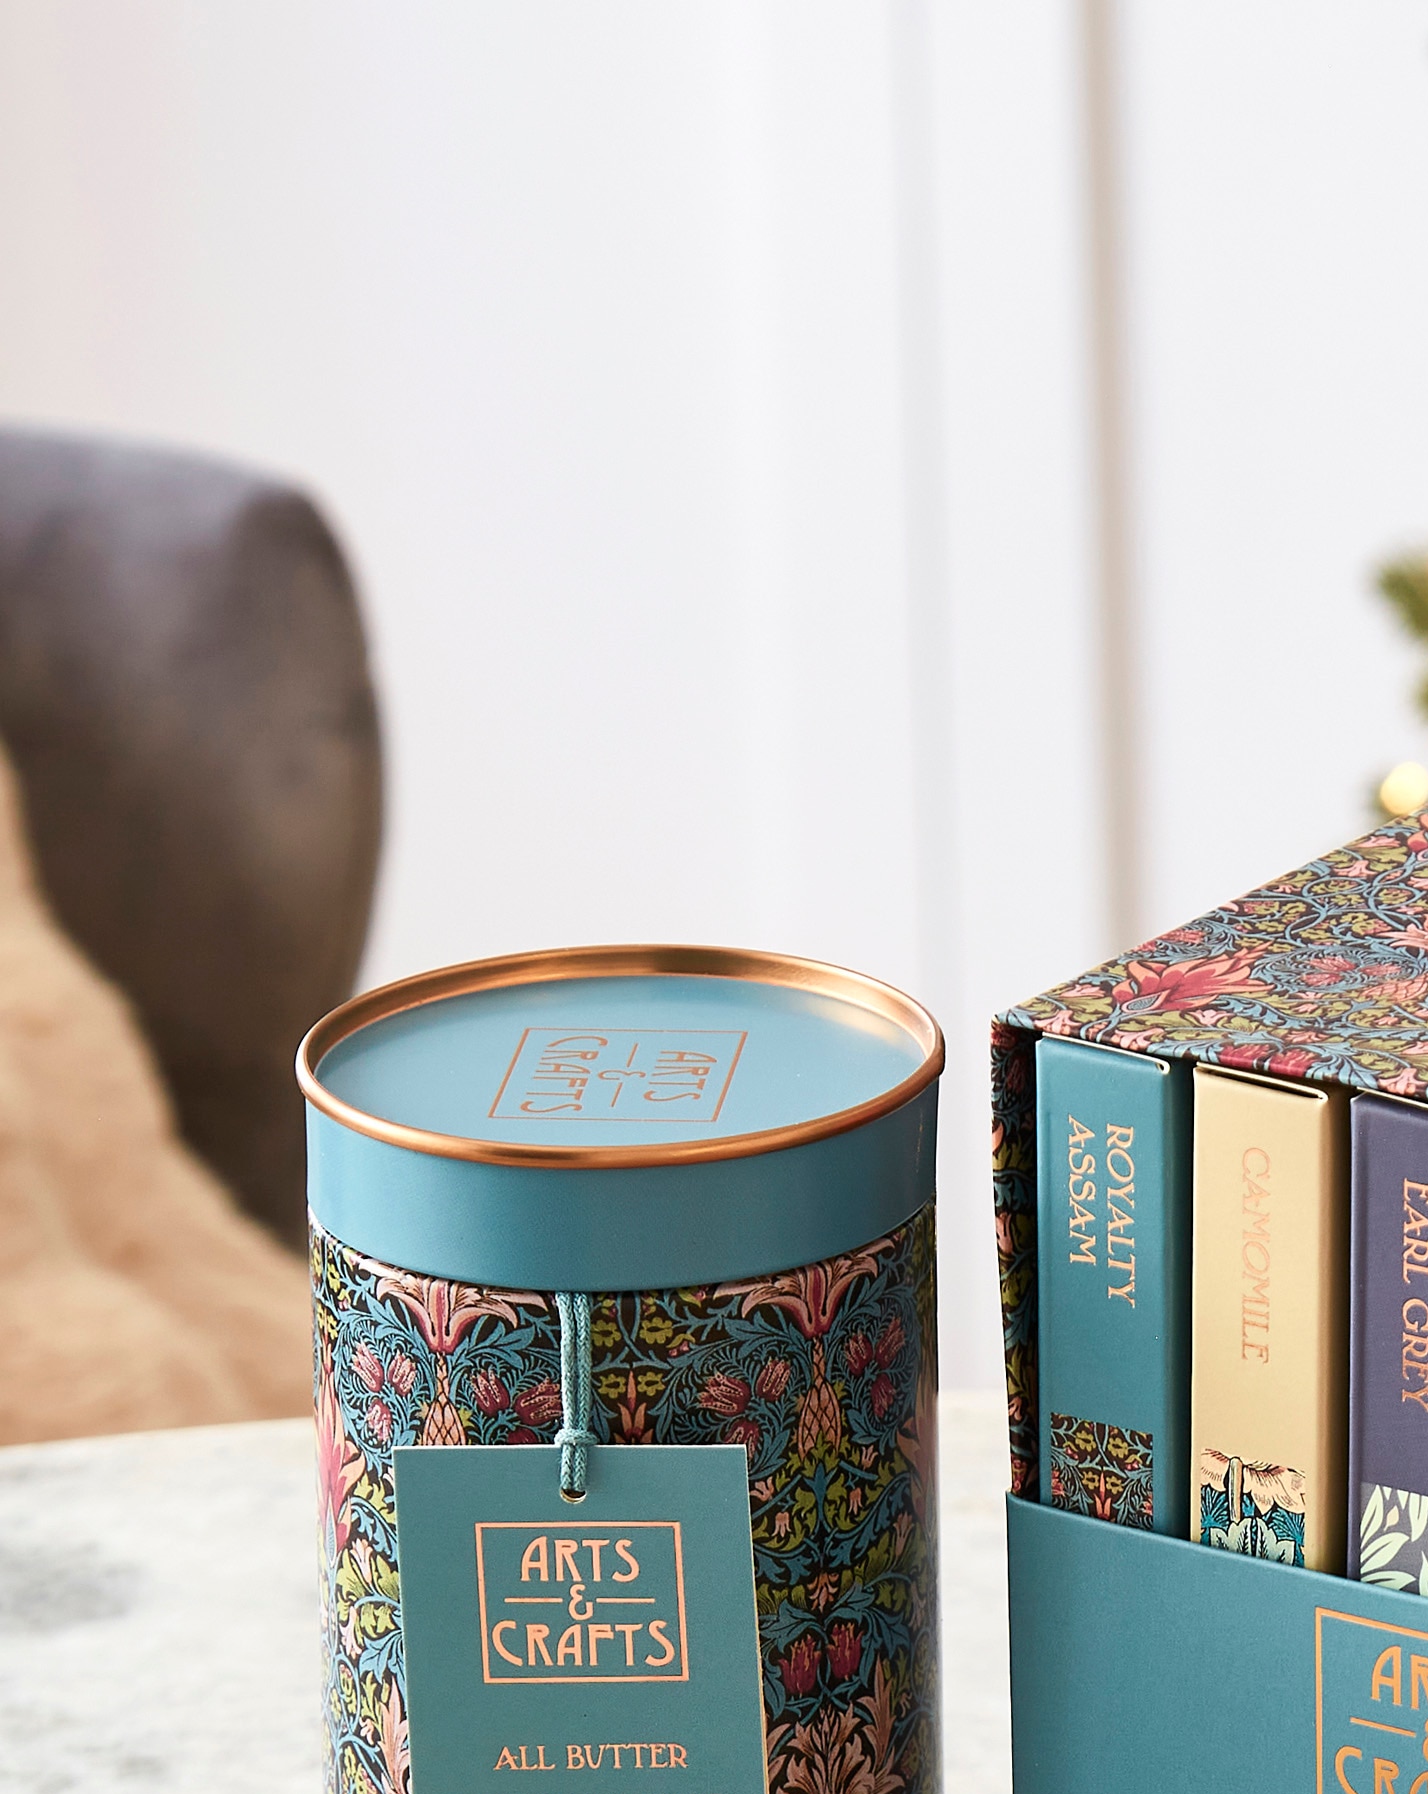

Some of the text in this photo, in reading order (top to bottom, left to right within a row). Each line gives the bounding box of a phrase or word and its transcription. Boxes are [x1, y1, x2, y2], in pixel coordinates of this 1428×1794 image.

[520, 1035, 608, 1113] CRAFTS
[597, 1069, 646, 1080] &
[643, 1051, 717, 1102] ARTS
[1067, 1113, 1097, 1267] ASSAM
[1106, 1123, 1136, 1309] ROYALTY
[1241, 1146, 1273, 1365] CAMOMILE
[520, 1535, 640, 1583] ARTS
[568, 1583, 594, 1621] &
[491, 1619, 676, 1667] CRAFTS
[493, 1743, 689, 1771] ALL BUTTER
